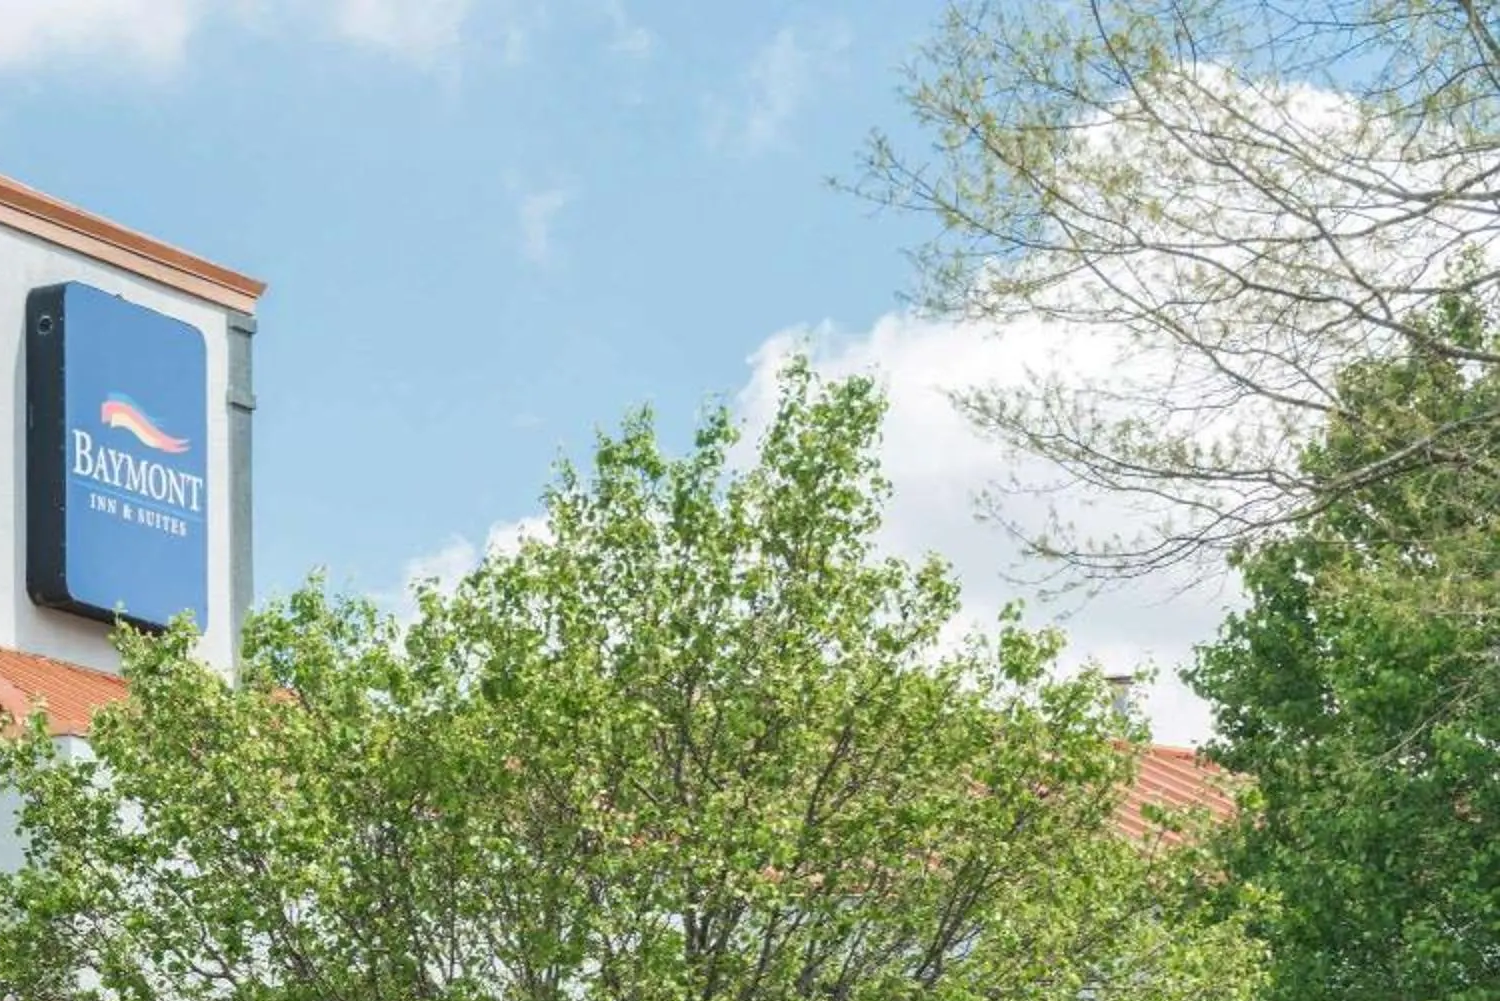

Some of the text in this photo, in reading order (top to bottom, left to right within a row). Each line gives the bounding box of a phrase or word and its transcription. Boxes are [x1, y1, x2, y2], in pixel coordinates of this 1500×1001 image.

[72, 429, 203, 512] BAYMONT
[89, 493, 187, 537] INN & SUITES
